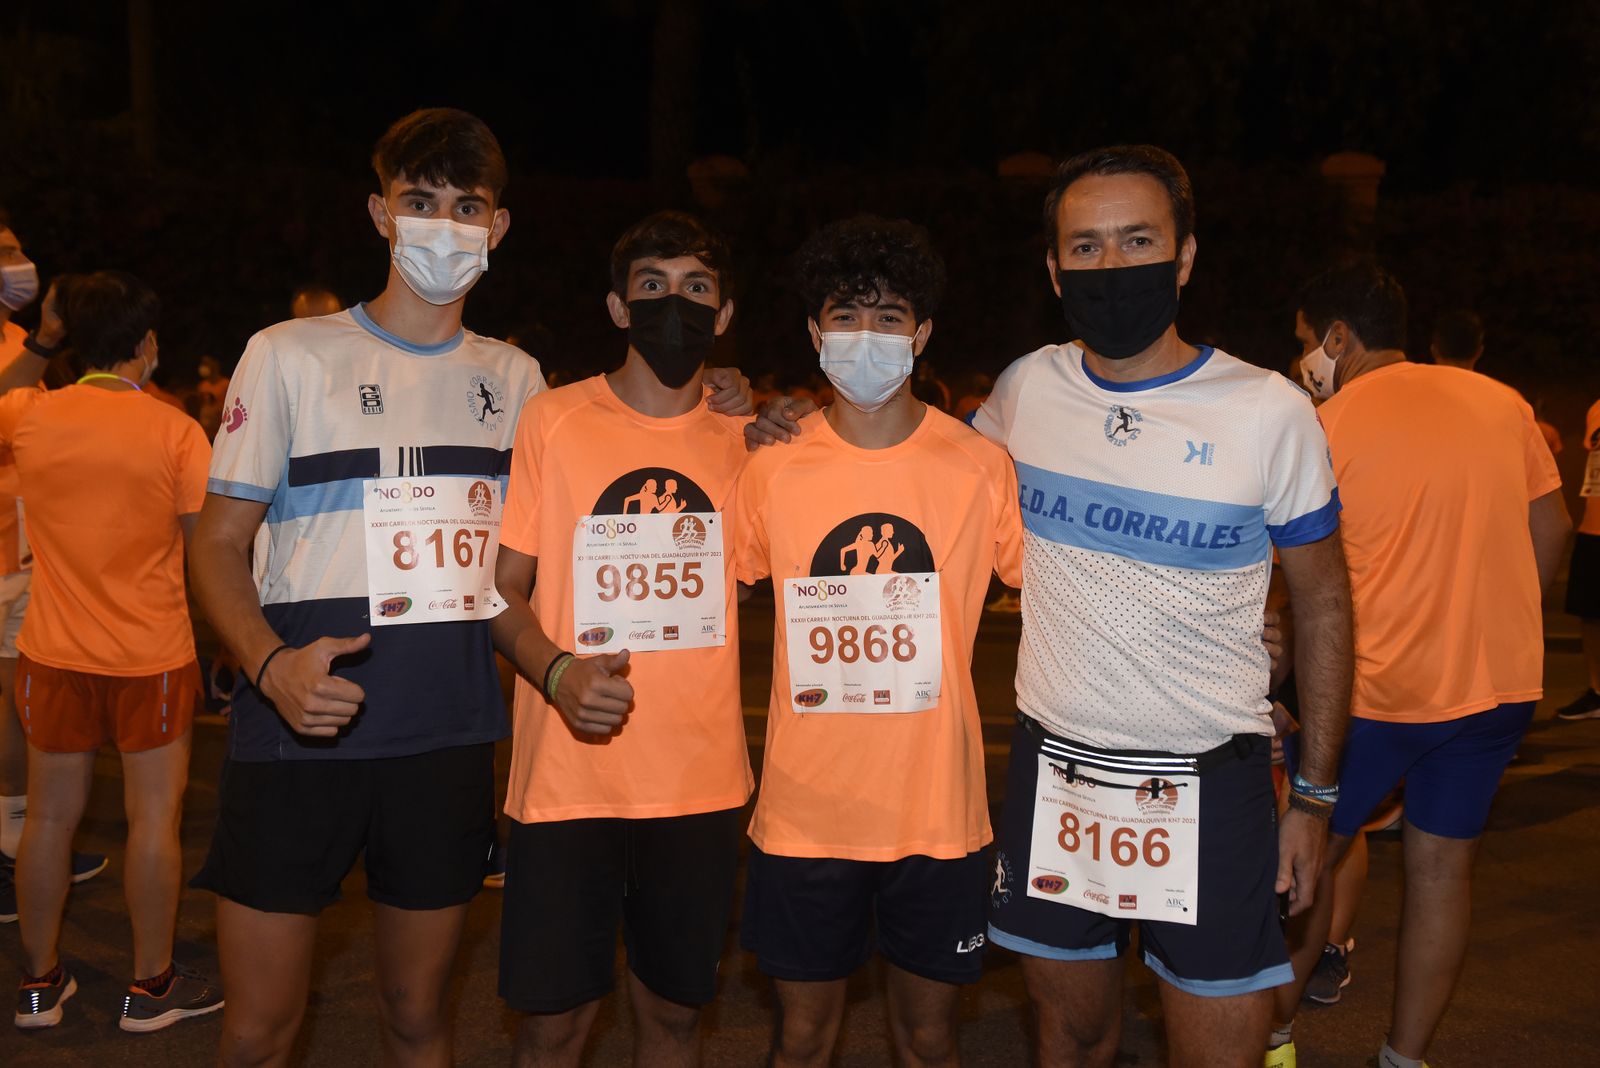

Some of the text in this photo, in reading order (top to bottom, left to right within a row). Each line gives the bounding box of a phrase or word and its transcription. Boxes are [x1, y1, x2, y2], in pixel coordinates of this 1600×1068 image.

[1084, 503, 1244, 549] CORRALES
[393, 528, 490, 571] 8167
[661, 550, 698, 560] GUADALQUIVIR
[596, 562, 704, 602] 9855
[701, 624, 716, 632] ABC
[832, 614, 860, 622] NOCTURNA
[809, 624, 917, 664] 9868
[1059, 799, 1079, 810] CARRERA
[1079, 807, 1107, 819] NOCTURNA
[1146, 804, 1175, 812] NOCTURNA
[1058, 812, 1171, 868] 8166
[1167, 898, 1185, 906] ABC
